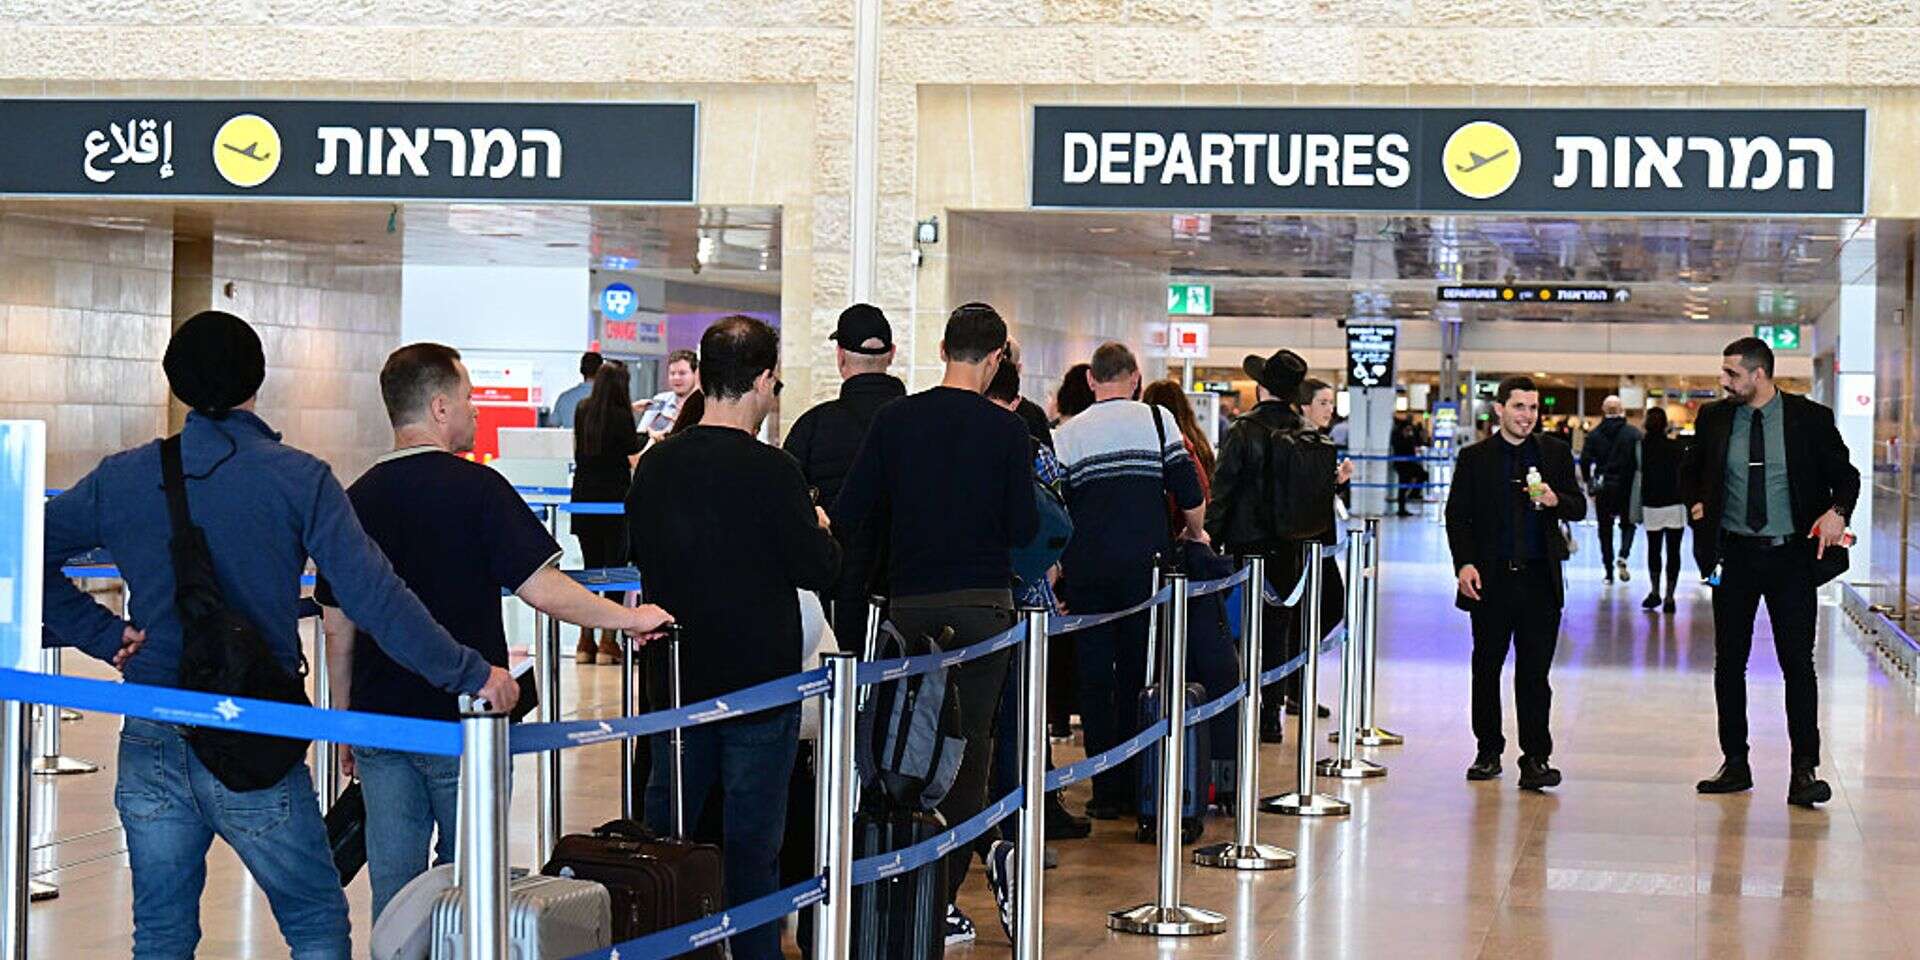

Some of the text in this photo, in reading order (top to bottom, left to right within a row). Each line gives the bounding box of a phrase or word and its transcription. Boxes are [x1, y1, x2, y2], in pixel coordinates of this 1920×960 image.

[84, 119, 174, 182] إقلاع
[316, 127, 562, 179] המראות
[1063, 132, 1411, 187] DEPARTURES
[1554, 136, 1834, 190] המראות
[606, 320, 637, 341] CHANGE
